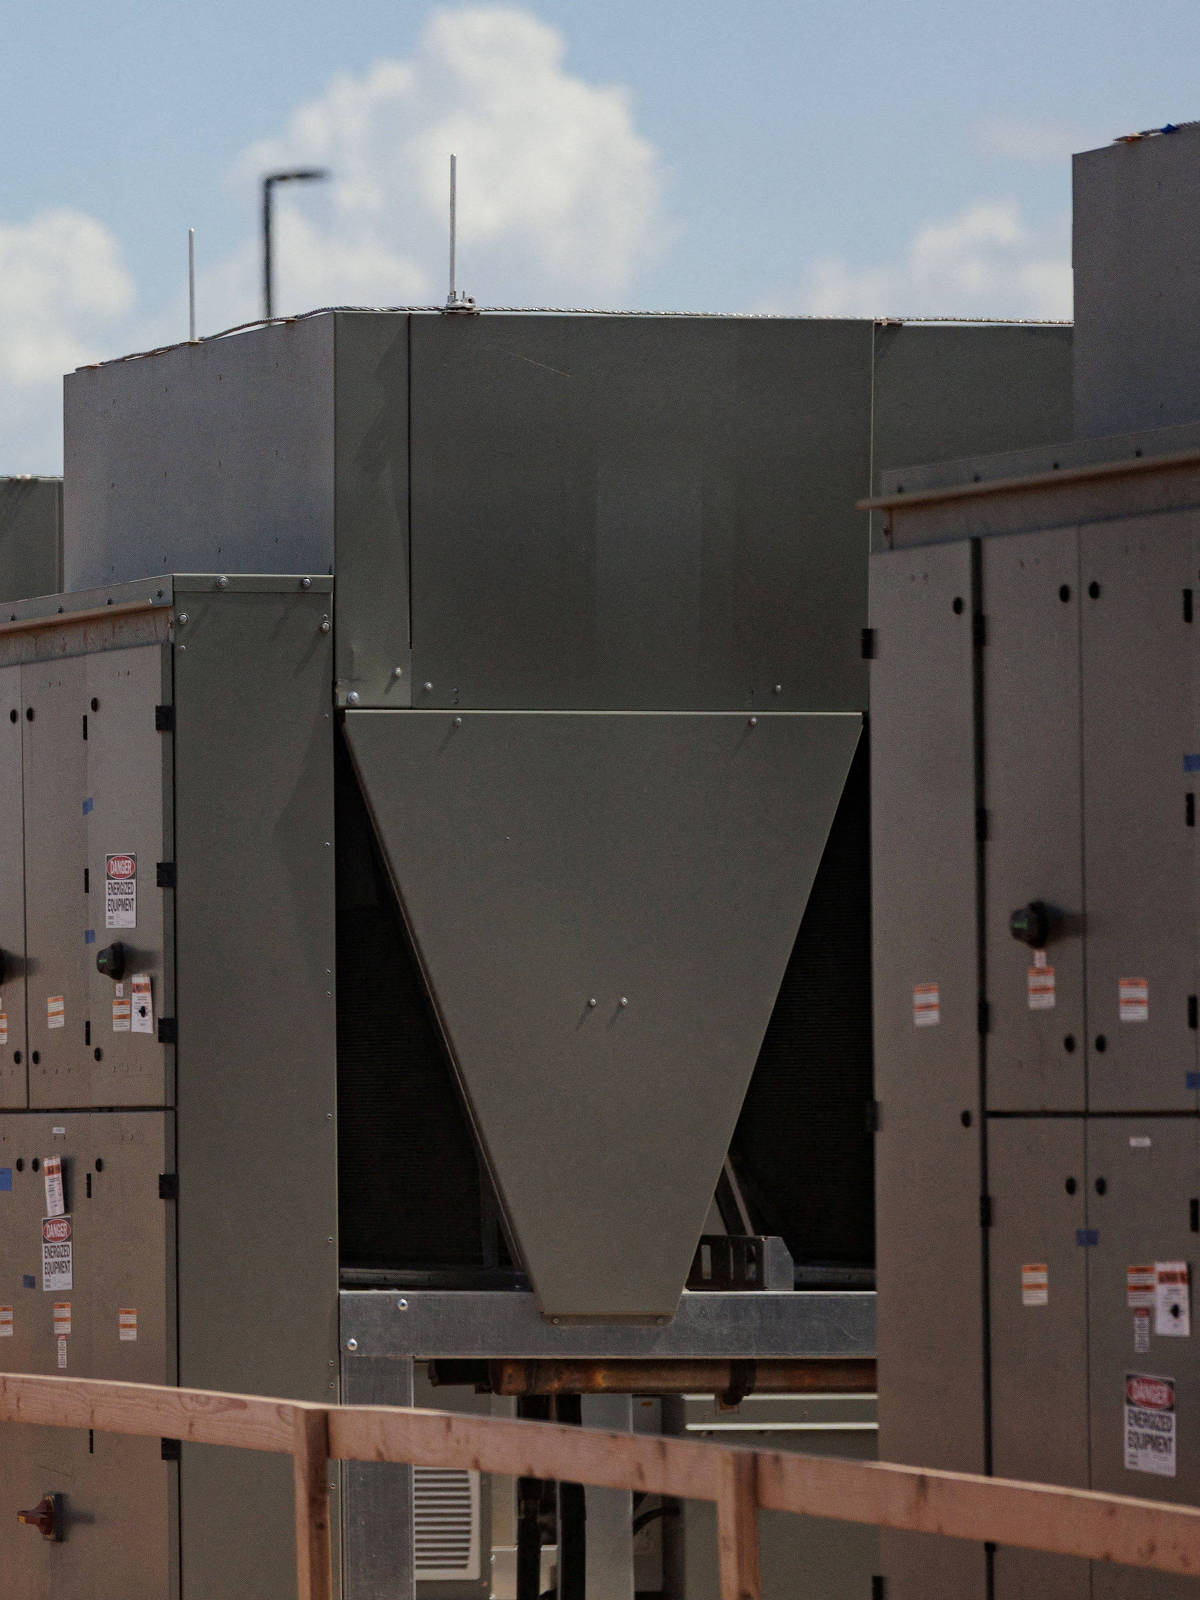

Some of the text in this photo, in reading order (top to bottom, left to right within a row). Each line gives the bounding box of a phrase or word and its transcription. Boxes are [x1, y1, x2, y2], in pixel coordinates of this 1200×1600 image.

[110, 859, 131, 874] DANGER
[108, 882, 134, 896] ENERGIZED
[108, 898, 134, 913] EQUIPMENT
[47, 1223, 68, 1238] DANGER
[44, 1245, 71, 1258] ENERGIZED
[44, 1261, 71, 1276] EQUIPMENT
[1132, 1381, 1170, 1403] DANGER
